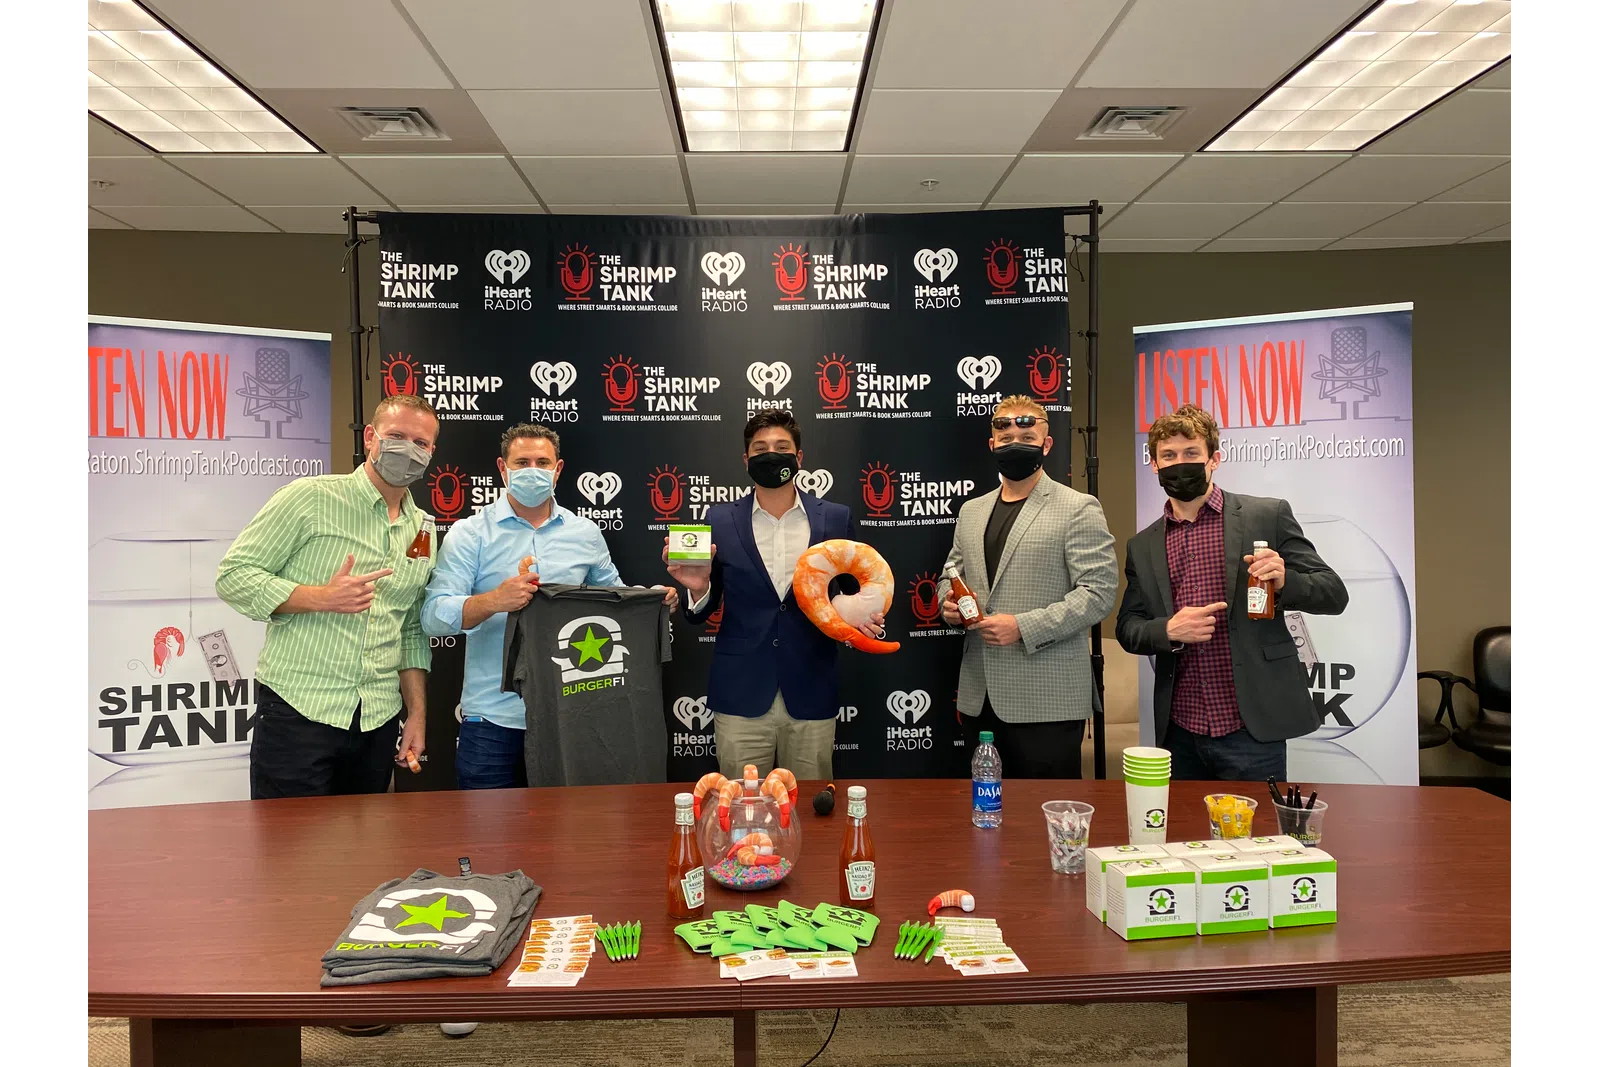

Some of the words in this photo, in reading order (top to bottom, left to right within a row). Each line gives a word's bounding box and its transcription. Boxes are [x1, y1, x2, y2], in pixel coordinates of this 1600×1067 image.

[381, 251, 402, 262] THE
[812, 254, 834, 264] THE
[1023, 248, 1044, 258] THE
[599, 255, 621, 265] THE
[381, 263, 459, 280] SHRIMP
[600, 266, 677, 284] SHRIMP
[814, 264, 888, 282] SHRIMP
[380, 281, 435, 298] TANK
[484, 286, 532, 298] iHeart
[600, 284, 654, 302] TANK
[702, 287, 746, 300] iHeart
[814, 282, 867, 300] TANK
[914, 284, 960, 298] iHeart
[484, 299, 532, 310] RADIO
[702, 300, 748, 312] RADIO
[915, 296, 961, 310] RADIO
[423, 364, 446, 374] THE
[643, 366, 665, 376] THE
[856, 363, 877, 373] THE
[424, 375, 504, 392] SHRIMP
[644, 377, 720, 394] SHRIMP
[856, 374, 932, 391] SHRIMP
[1138, 345, 1228, 432] LISTEN
[1239, 340, 1304, 427] NOW
[158, 350, 229, 440] NOW
[856, 392, 908, 409] TANK
[957, 392, 1002, 404] iHeart
[424, 394, 480, 410] TANK
[530, 397, 578, 410] iHeart
[644, 396, 698, 412] TANK
[746, 398, 792, 410] iHeart
[531, 410, 578, 422] RADIO
[470, 476, 492, 486] THE
[688, 476, 710, 485] THE
[900, 472, 921, 482] THE
[690, 486, 755, 502] SHRIM
[900, 480, 975, 499] SHRIMP
[577, 507, 622, 518] iHeart
[900, 499, 952, 516] TANK
[598, 520, 624, 530] DIO
[430, 636, 456, 648] DIO
[562, 676, 624, 696] BURGERFI
[886, 726, 932, 738] iHeart
[887, 738, 932, 751] RADIO
[978, 786, 1002, 800] DASA
